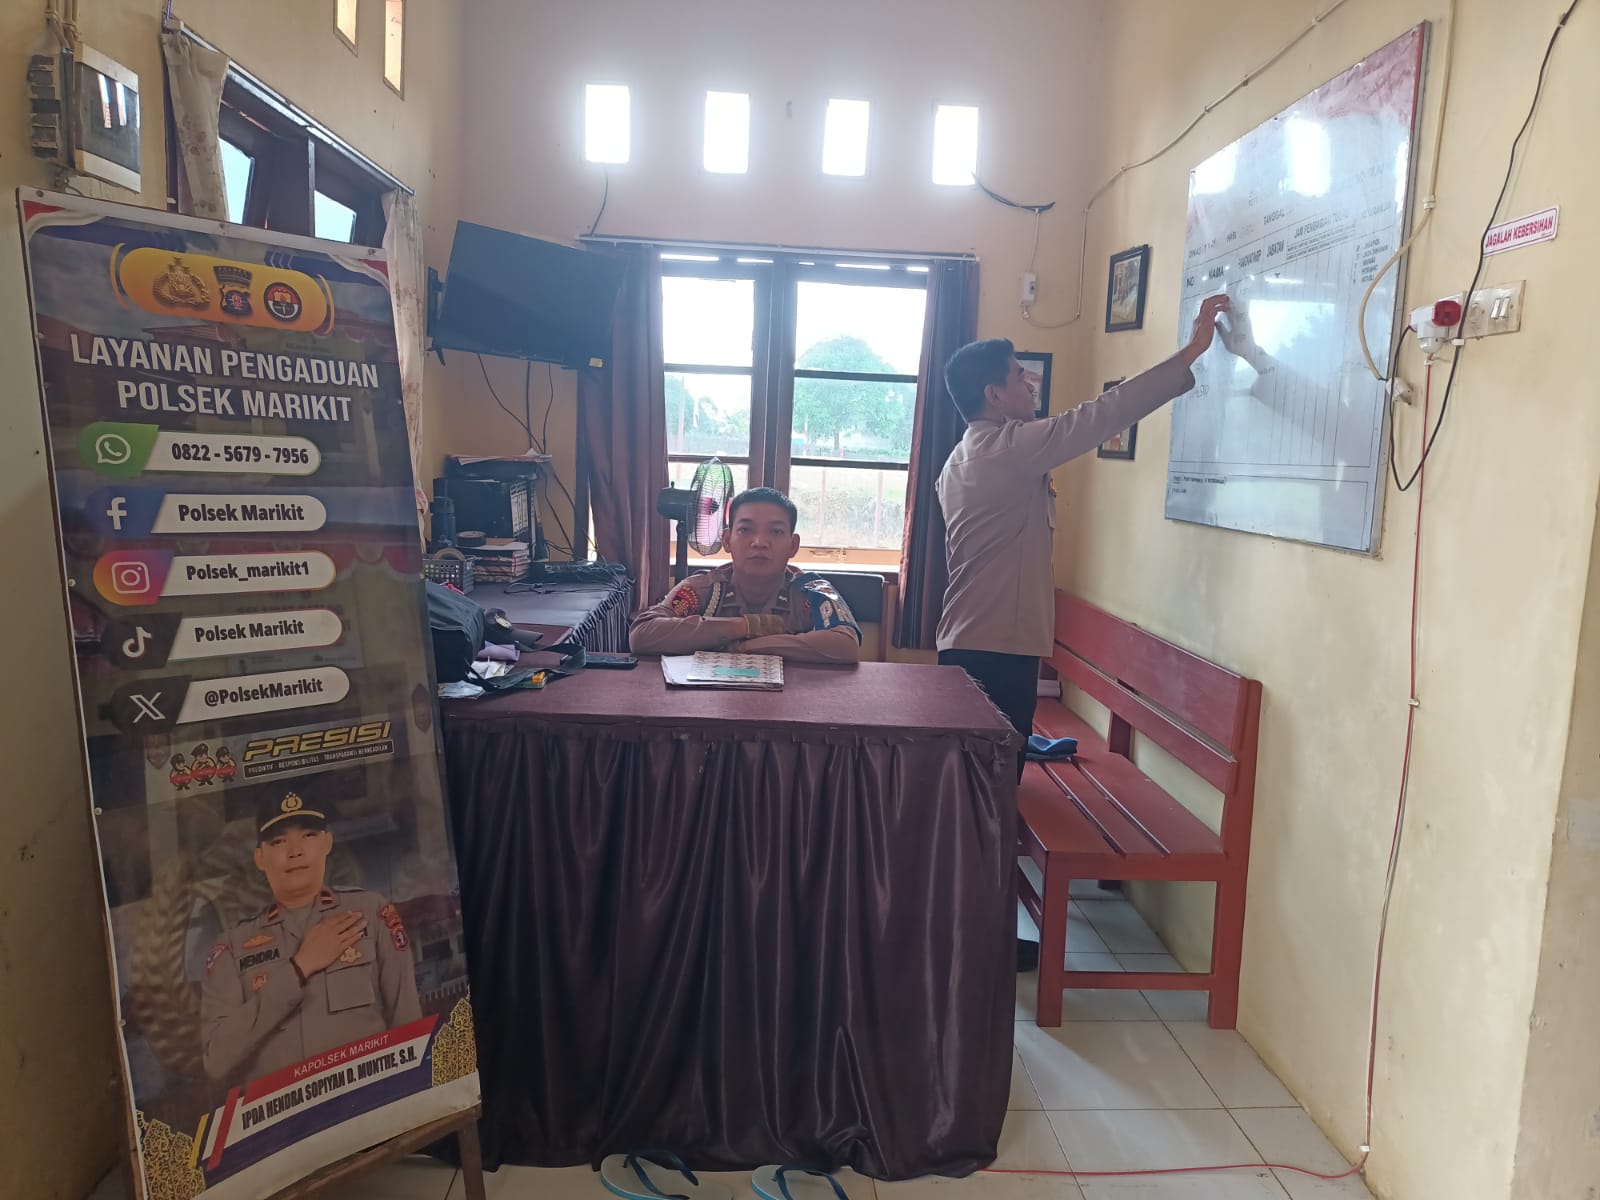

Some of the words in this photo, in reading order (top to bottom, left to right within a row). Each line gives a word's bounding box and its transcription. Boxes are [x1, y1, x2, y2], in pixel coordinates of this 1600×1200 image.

[1486, 229, 1513, 248] JAGALAH
[1513, 216, 1554, 240] KEBERSIHAN
[70, 333, 213, 375] LAYANAN
[220, 349, 379, 388] PENGADUAN
[117, 380, 235, 415] POLSEK
[242, 389, 351, 422] MARIKIT
[171, 443, 211, 461] 0822
[224, 445, 262, 463] 5679
[273, 447, 309, 464] 7956
[178, 503, 239, 522] Polsek
[241, 504, 304, 521] Marikit
[186, 561, 309, 581] Polsek_marikit1
[194, 623, 247, 643] Polsek
[249, 619, 305, 639] Marikit
[204, 678, 323, 707] @PolsekMarikit
[244, 721, 391, 761] PRESISI
[239, 948, 280, 972] HENDRA
[294, 1048, 348, 1078] KAPOLSEK
[349, 1034, 389, 1056] MARIKIT
[242, 1107, 266, 1130] IPDA
[266, 1088, 303, 1118] HENDRA
[305, 1071, 345, 1100] SOPIYAN
[347, 1067, 356, 1084] D.
[358, 1054, 398, 1079] MUNTHE,
[399, 1046, 417, 1065] S.H.
